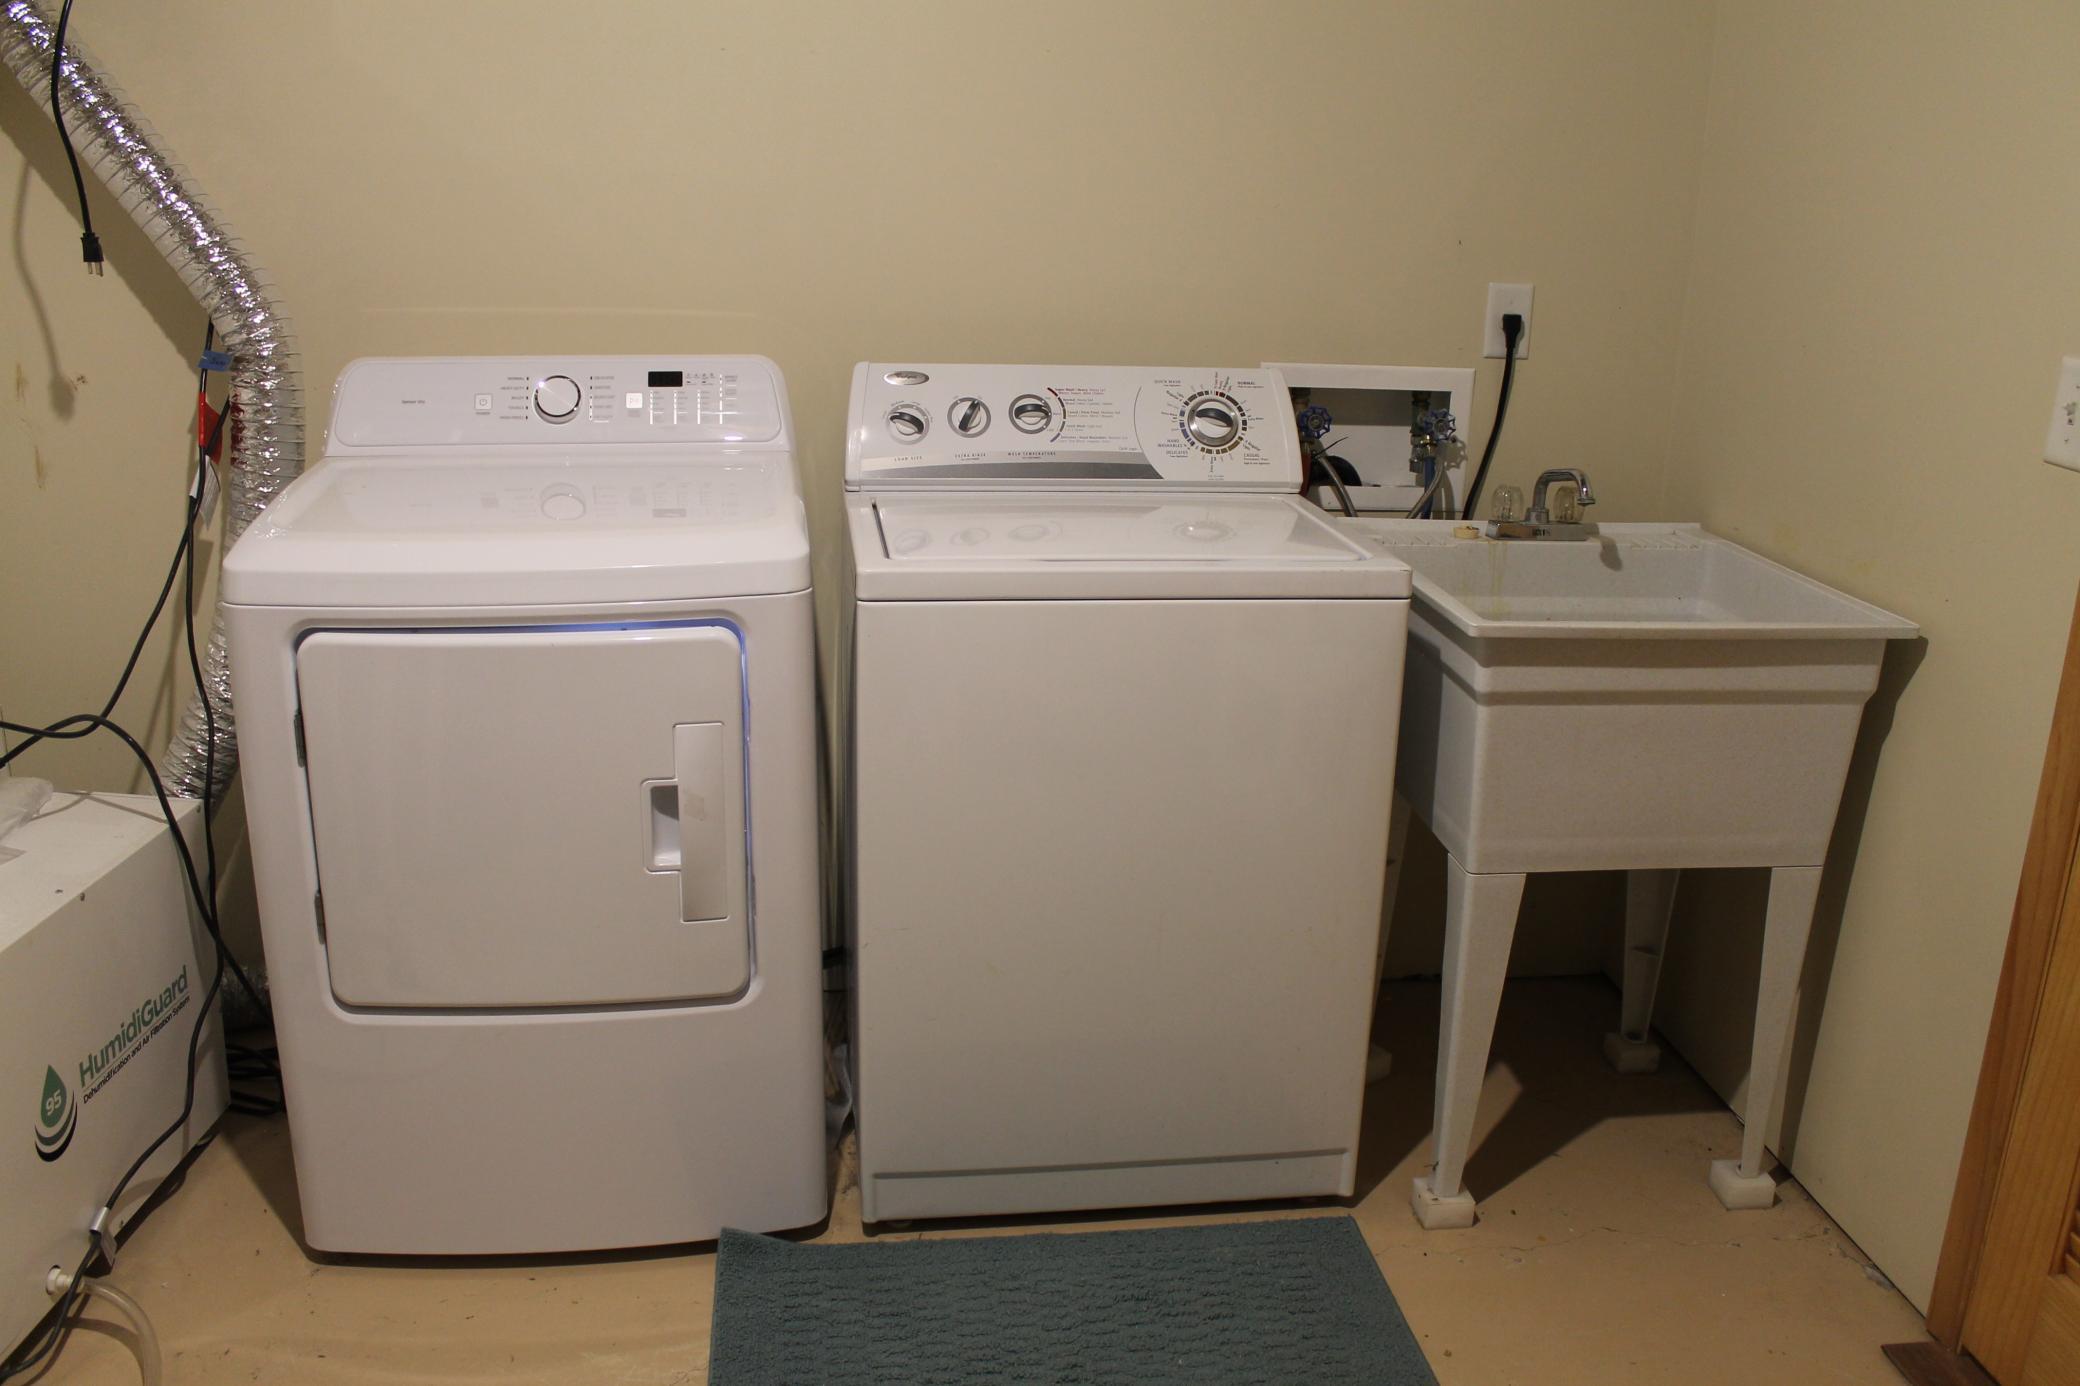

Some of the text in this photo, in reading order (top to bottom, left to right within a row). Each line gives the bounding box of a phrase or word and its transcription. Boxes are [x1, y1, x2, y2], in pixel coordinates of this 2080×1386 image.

[79, 965, 188, 1088] HumidiGuard
[45, 1089, 62, 1116] 95
[83, 1053, 131, 1104] Dehumidification
